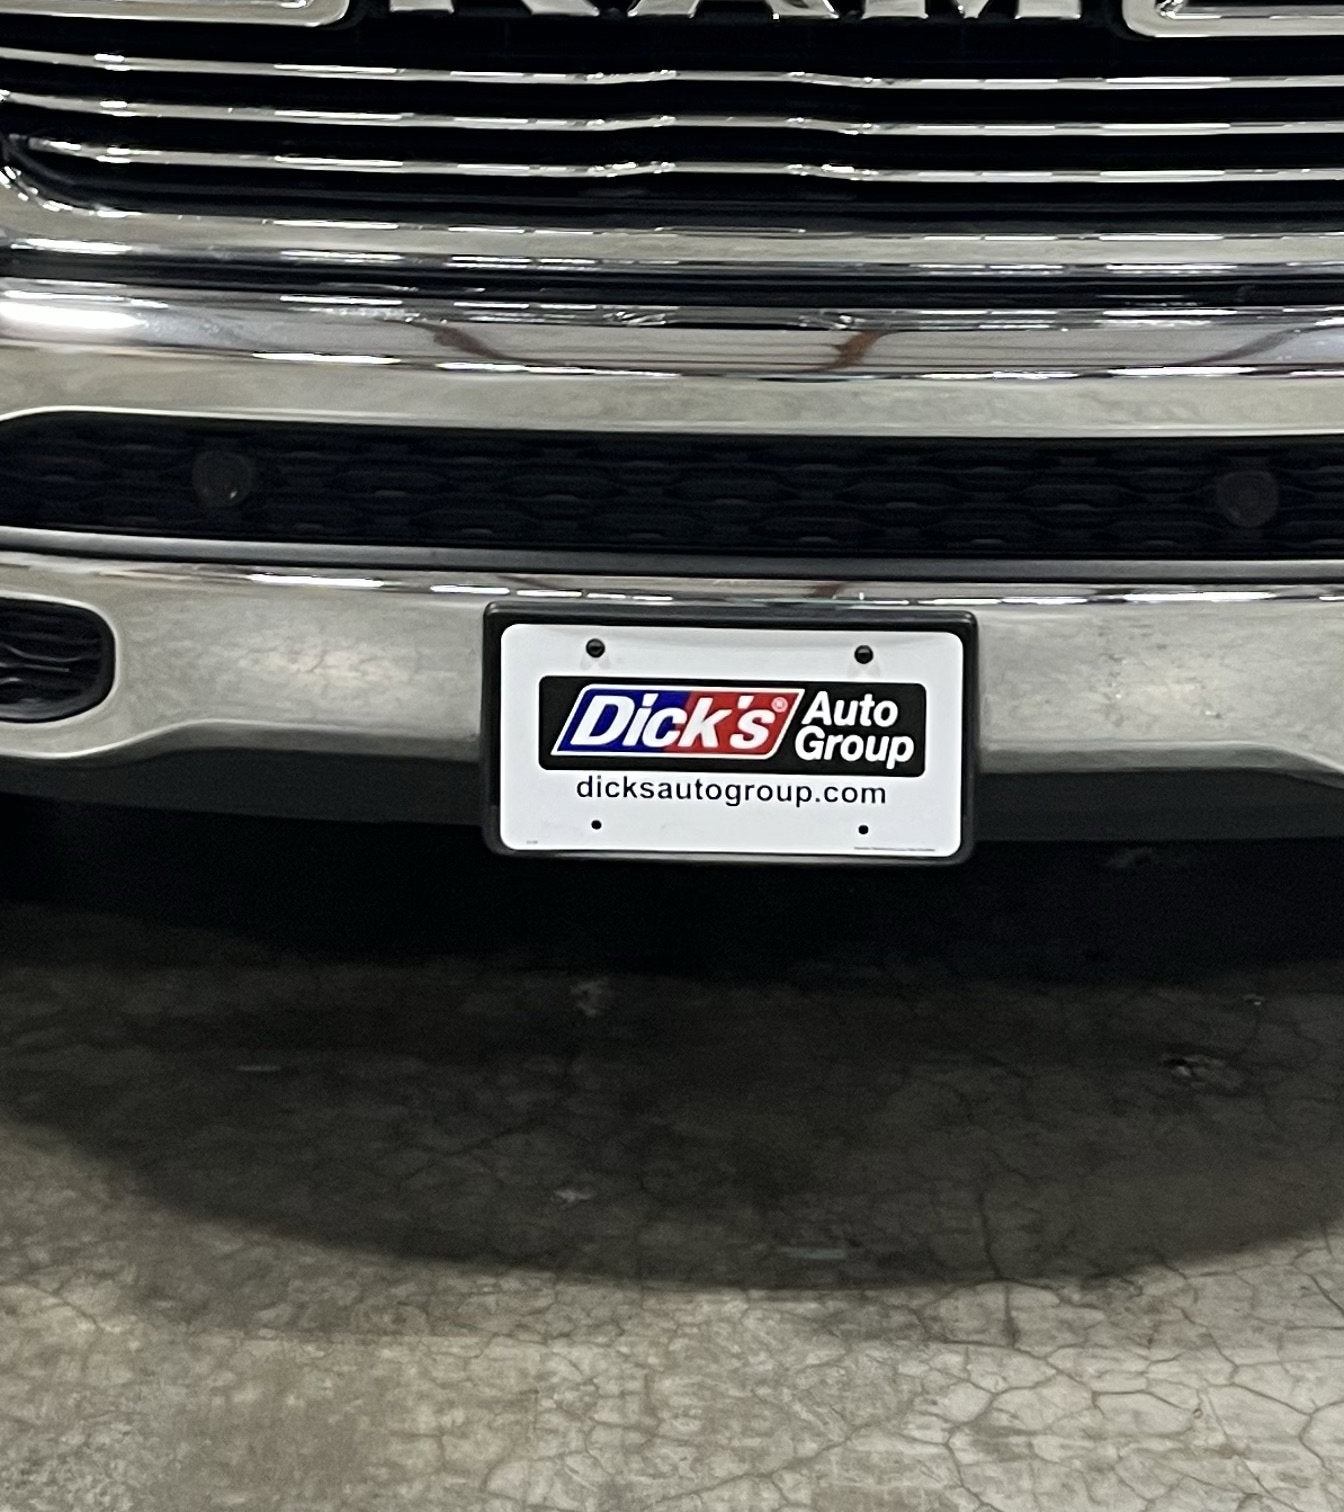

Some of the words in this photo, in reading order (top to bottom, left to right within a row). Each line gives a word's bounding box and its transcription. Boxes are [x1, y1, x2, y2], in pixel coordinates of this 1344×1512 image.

[801, 690, 899, 727] Auto
[794, 724, 915, 769] Group
[576, 775, 887, 808] dicksautogroup.com
